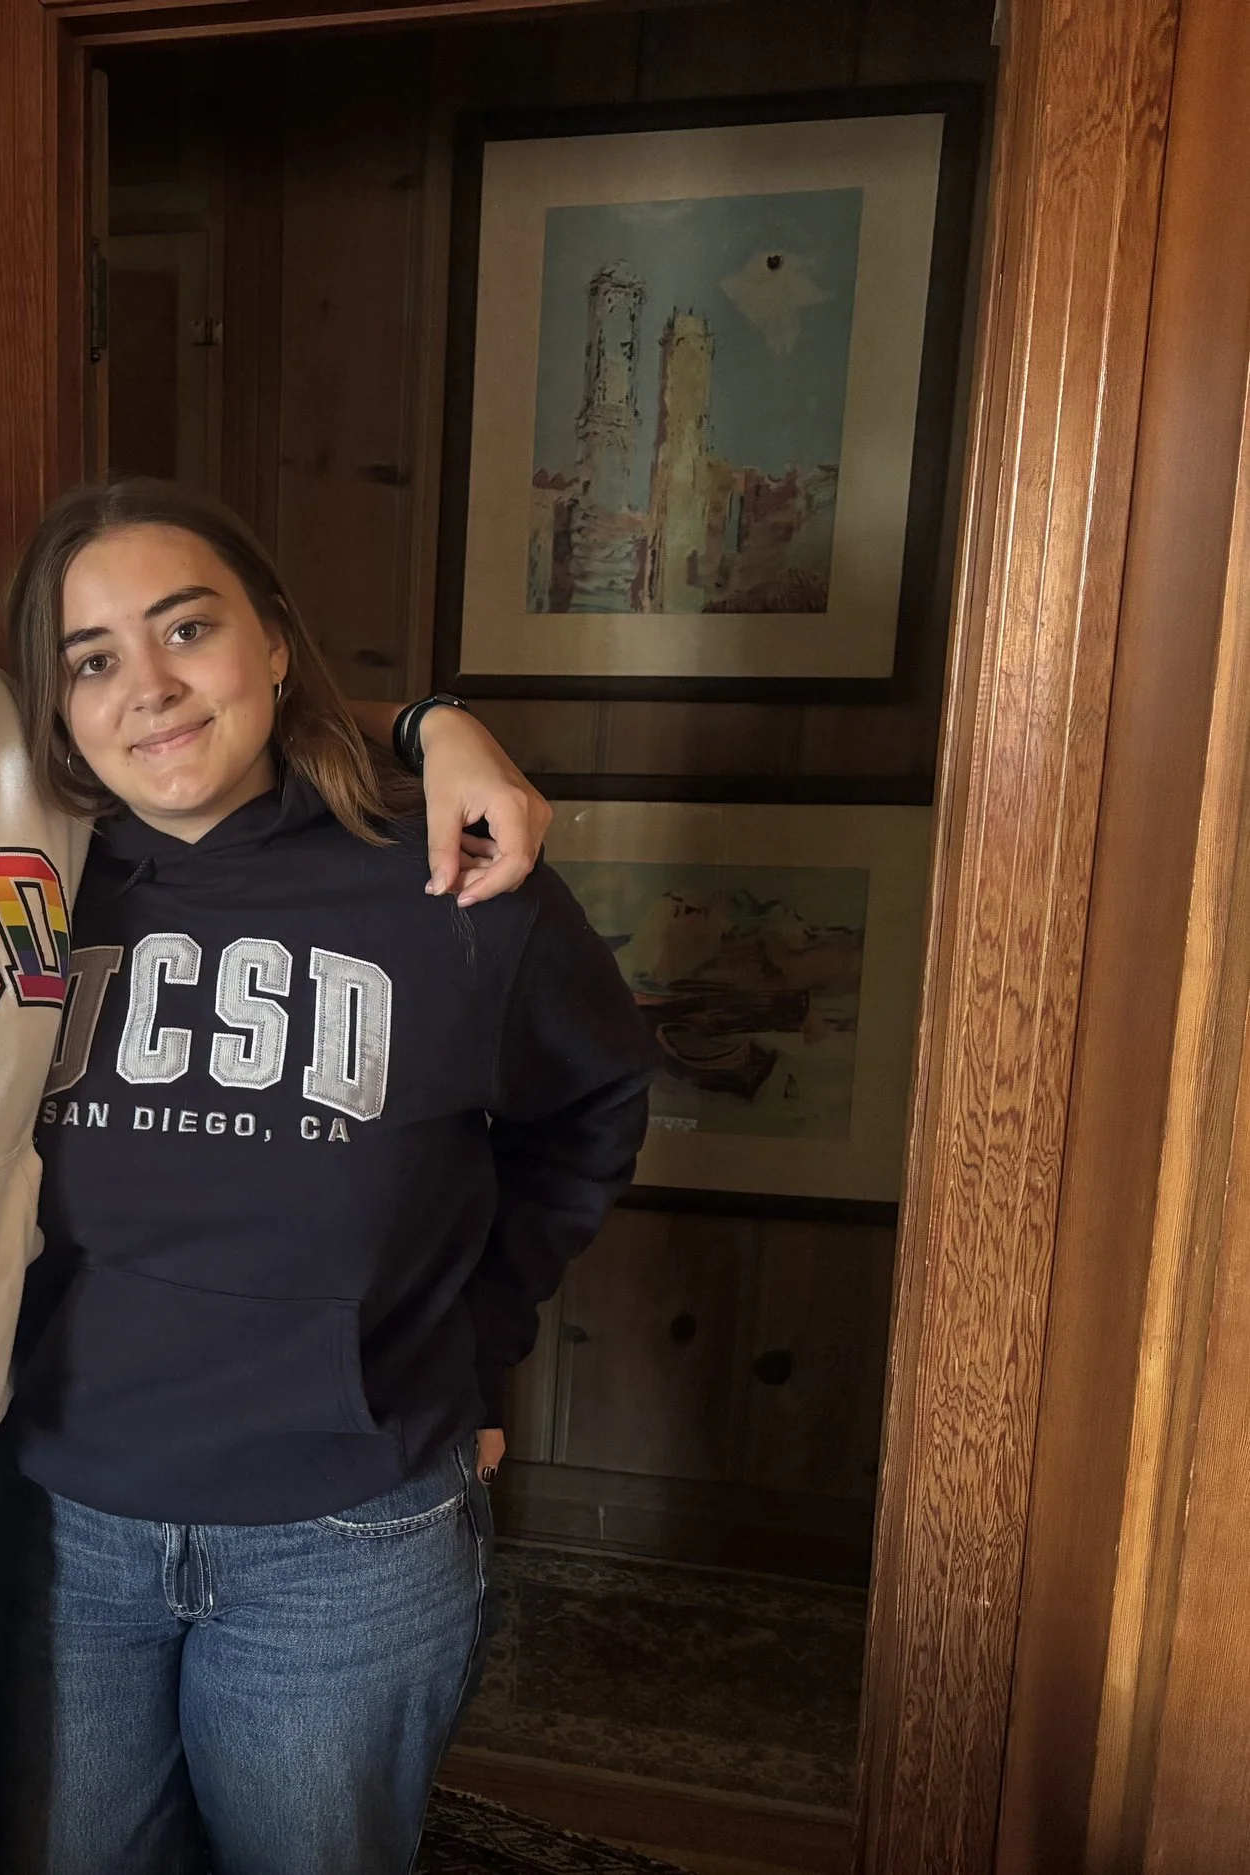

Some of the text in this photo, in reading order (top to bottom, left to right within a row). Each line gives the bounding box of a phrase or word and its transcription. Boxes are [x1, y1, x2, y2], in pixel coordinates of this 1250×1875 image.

[41, 1101, 352, 1144] SAN DIEGO, CA
